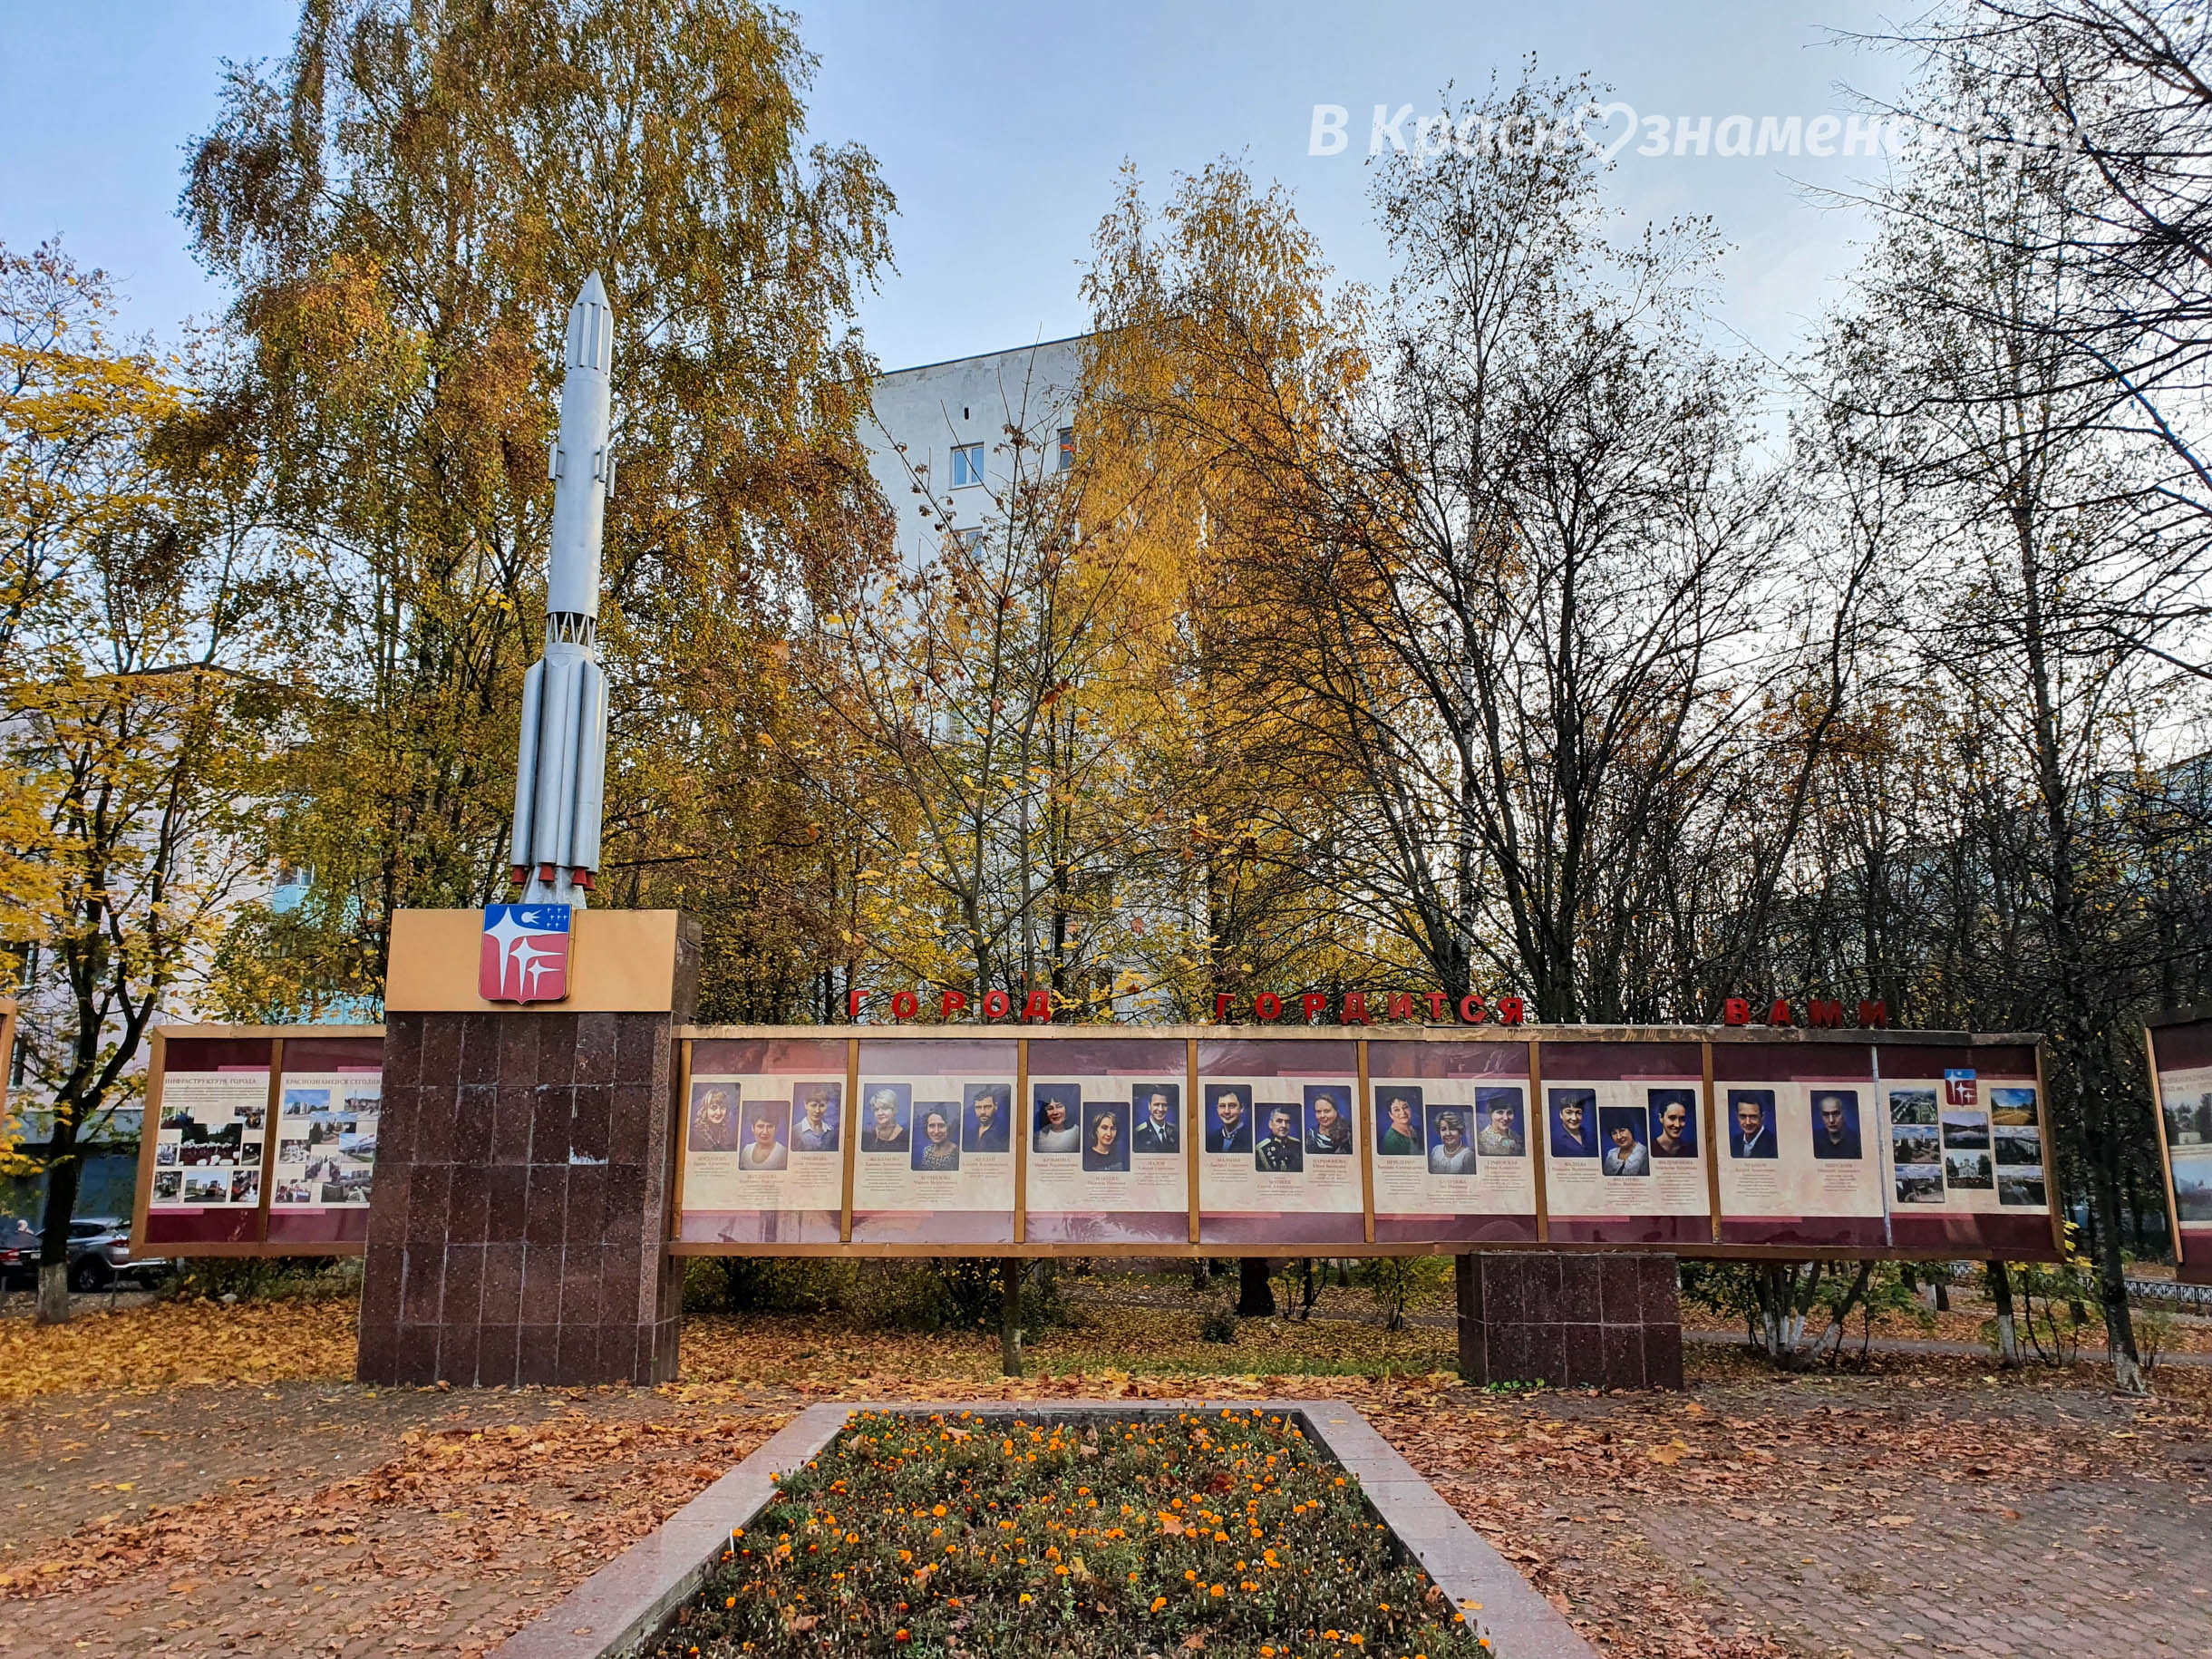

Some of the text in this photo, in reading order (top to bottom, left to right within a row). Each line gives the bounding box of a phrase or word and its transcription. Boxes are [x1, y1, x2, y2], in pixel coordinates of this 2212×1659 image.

[849, 990, 1887, 1026] ГОРОД ГОРДИТСЯ ВАМИ
